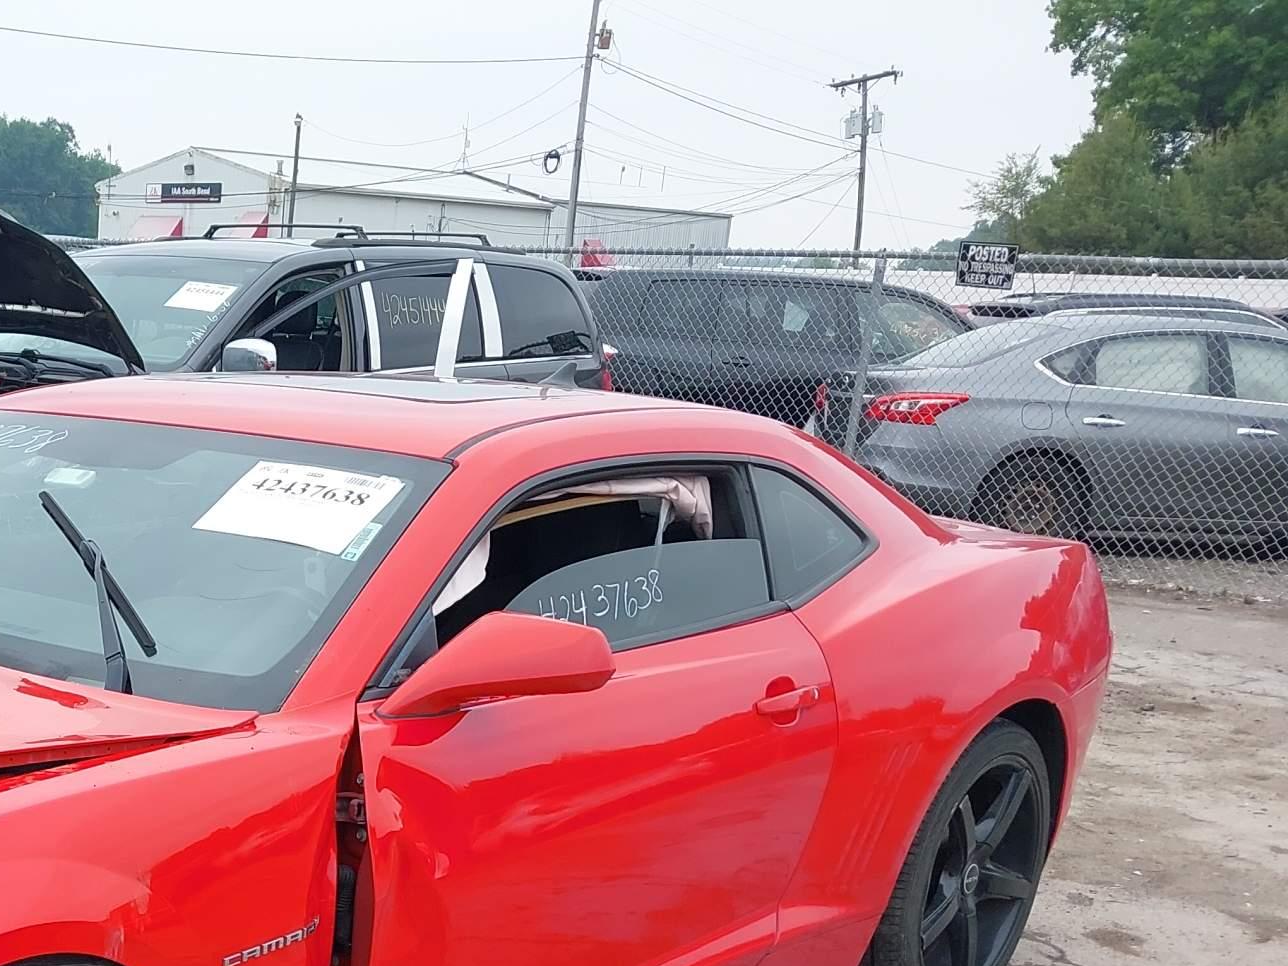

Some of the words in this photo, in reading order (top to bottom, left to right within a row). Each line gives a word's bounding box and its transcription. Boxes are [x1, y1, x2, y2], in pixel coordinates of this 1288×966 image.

[968, 245, 1009, 262] POSTED
[965, 273, 986, 283] KEEP
[987, 275, 1005, 285] OUT
[252, 478, 371, 506] 42437638
[538, 569, 663, 626] 42437638
